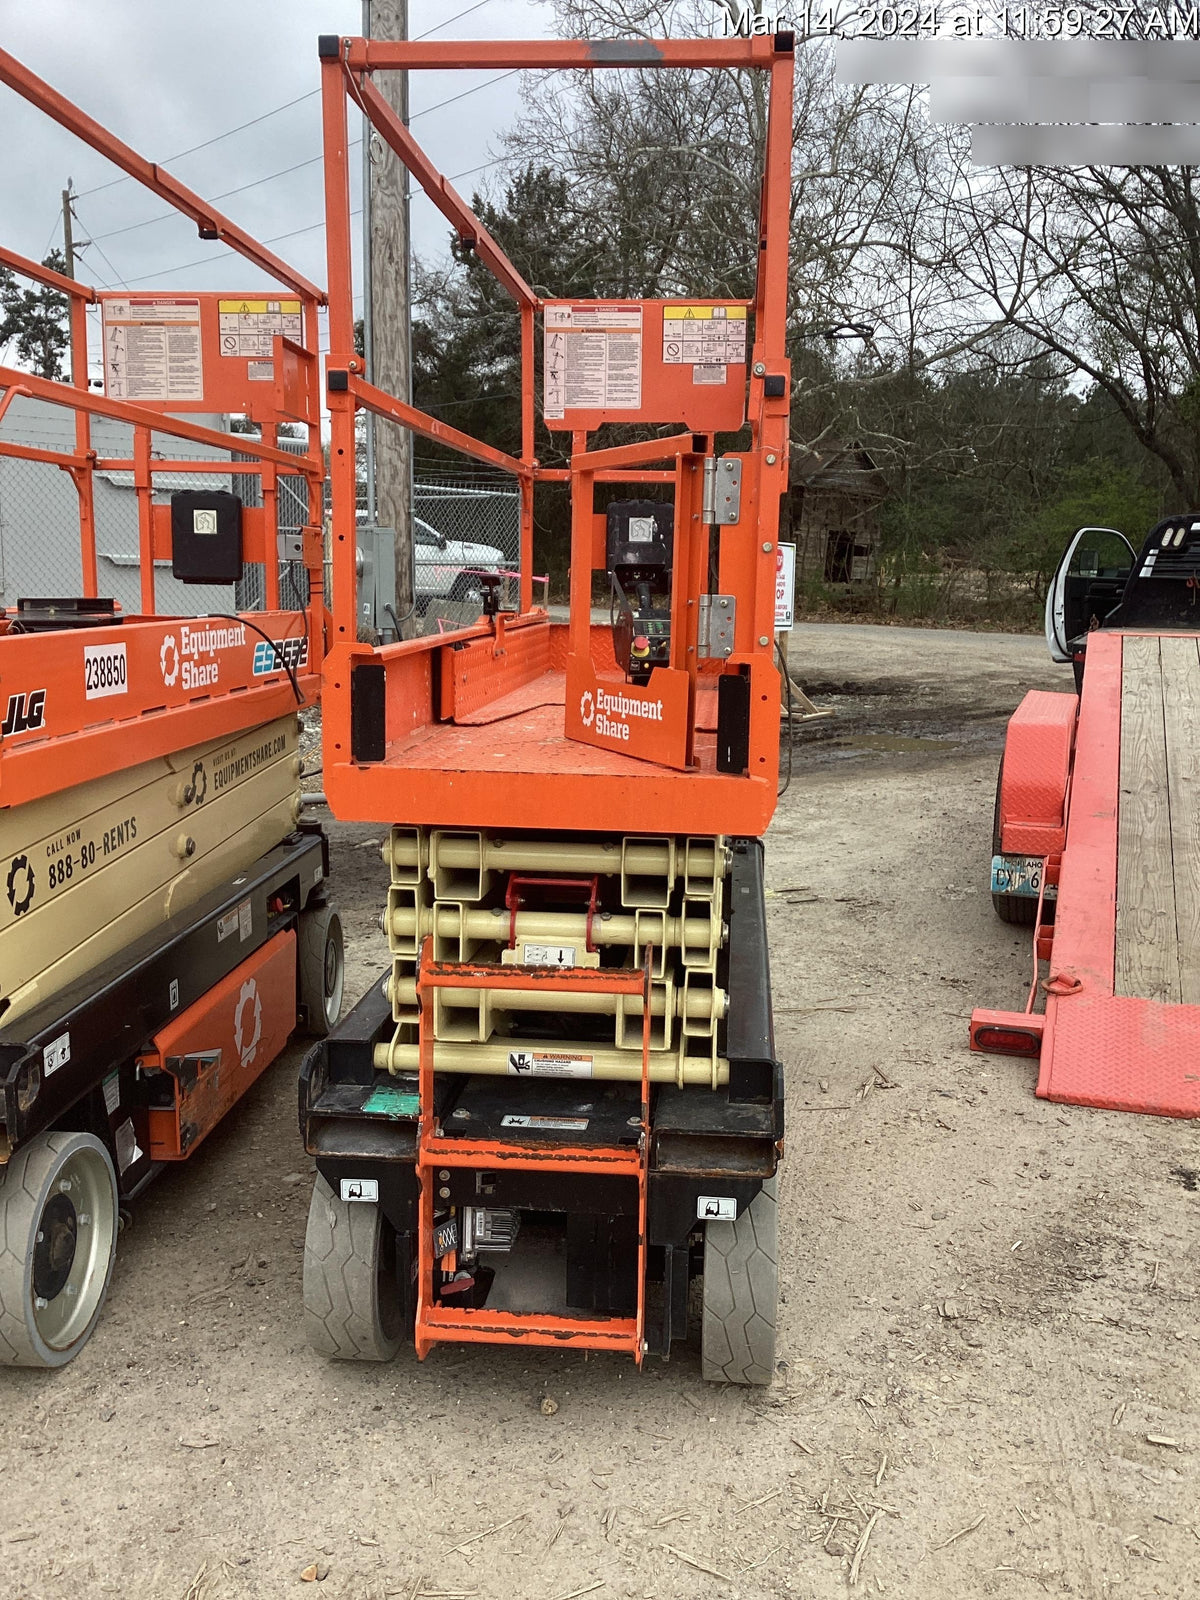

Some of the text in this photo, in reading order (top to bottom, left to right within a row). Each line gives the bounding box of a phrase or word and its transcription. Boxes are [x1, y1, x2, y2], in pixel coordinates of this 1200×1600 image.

[180, 623, 246, 660] Equipment
[85, 653, 126, 691] 238850
[181, 660, 219, 690] Share
[1, 688, 46, 737] JLG
[596, 688, 663, 721] Equipment
[595, 713, 630, 740] Share
[213, 733, 286, 791] EQUIPMENTSHARE.COM
[46, 828, 81, 858] CALL NOW
[48, 816, 137, 889] 888-80-RENTS
